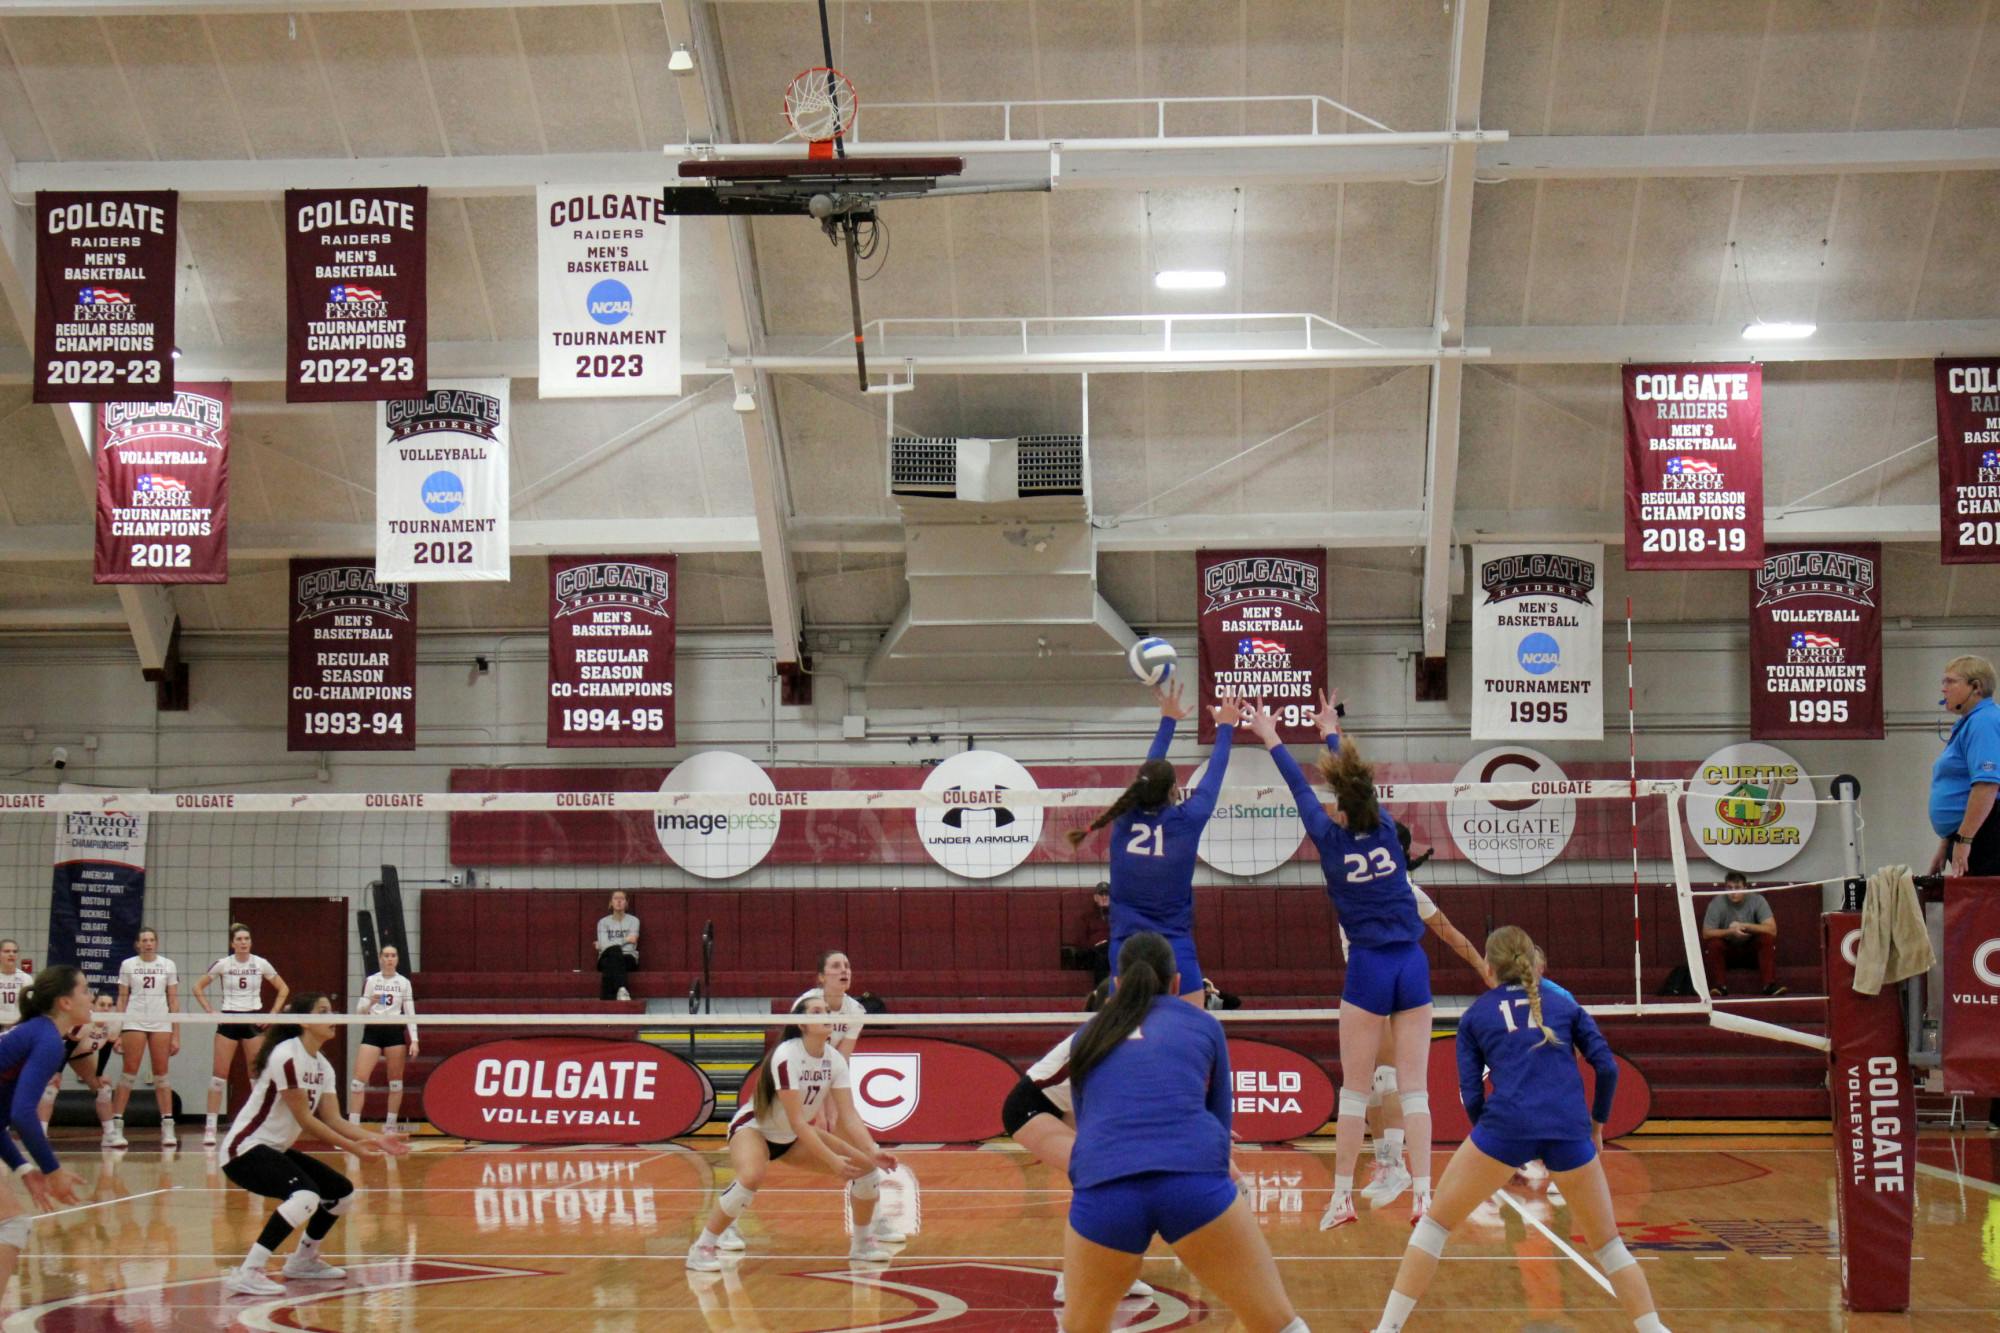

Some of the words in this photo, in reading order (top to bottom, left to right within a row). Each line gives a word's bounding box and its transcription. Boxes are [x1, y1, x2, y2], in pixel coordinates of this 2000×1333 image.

[48, 200, 165, 235] COLGATE
[298, 198, 414, 233] COLGATE
[550, 194, 667, 227] COLGATE
[71, 236, 142, 247] RAIDERS
[321, 233, 392, 246] RAIDERS
[573, 229, 644, 240] RAIDERS
[84, 252, 127, 266] MEN'S
[335, 250, 377, 264] MEN'S
[587, 246, 628, 259] MEN'S
[315, 264, 397, 279] BASKETBALL
[567, 259, 649, 273] BASKETBALL
[64, 266, 146, 281] BASKETBALL
[74, 303, 136, 312] PATRIOT
[325, 301, 388, 311] PATRIOT
[590, 302, 631, 315] NCAA
[74, 312, 136, 321] LEAGUE
[326, 309, 388, 319] LEAGUE
[56, 323, 107, 337] REGULAR
[109, 323, 154, 336] SEASON
[307, 320, 406, 334] TOURNAMENT
[55, 337, 154, 352] CHAMPIONS
[307, 334, 406, 351] CHAMPIONS
[552, 330, 667, 346] TOURNAMENT
[47, 360, 161, 384] 2022-23
[300, 357, 414, 383] 2022-23
[576, 354, 643, 378] 2023
[1635, 373, 1748, 401] COLGATE
[108, 394, 221, 426] COLGATE
[387, 390, 499, 424] COLGATE
[1657, 402, 1728, 419] RAIDERS
[124, 423, 203, 437] RAIDERS
[404, 421, 482, 434] RAIDERS
[1671, 424, 1714, 437] MEN'S
[1650, 438, 1737, 450] BASKETBALL
[119, 451, 207, 465] VOLLEYBALL
[400, 448, 487, 461] VOLLEYBALL
[1663, 473, 1725, 483] PATRIOT
[1662, 481, 1724, 490] LEAGUE
[1957, 486, 2000, 499] TOUR
[132, 489, 192, 500] PATRIOT
[425, 491, 464, 504] NCAA
[1641, 492, 1696, 505] REGULAR
[1699, 491, 1745, 504] SEASON
[132, 497, 191, 507] LEAGUE
[112, 508, 211, 522] TOURNAMENT
[1641, 506, 1746, 521] CHAMPIONS
[112, 521, 211, 537] CHAMPIONS
[389, 519, 496, 534] TOURNAMENT
[1643, 528, 1746, 552] 2018-19
[131, 544, 191, 568] 2012
[413, 541, 473, 564] 2012
[1483, 555, 1594, 587] COLGATE
[1762, 553, 1873, 585] COLGATE
[559, 564, 666, 597] COLGATE
[1207, 559, 1317, 594] COLGATE
[1224, 589, 1302, 602] RAIDERS
[1500, 584, 1577, 598] RAIDERS
[1777, 583, 1856, 596] RAIDERS
[316, 598, 391, 610] RAIDERS
[575, 594, 651, 607] RAIDERS
[1519, 602, 1558, 613] MEN'S
[592, 611, 631, 623] MEN'S
[1242, 607, 1282, 619] MEN'S
[1772, 610, 1860, 623] VOLLEYBALL
[334, 615, 373, 626] MEN'S
[1222, 619, 1303, 632] BASKETBALL
[1498, 615, 1579, 627] BASKETBALL
[314, 628, 393, 640] BASKETBALL
[572, 624, 652, 637] BASKETBALL
[575, 649, 648, 663] REGULAR
[1234, 653, 1291, 662] PATRIOT
[1522, 653, 1560, 665] NCAA
[1787, 648, 1846, 656] PATRIOT
[1787, 655, 1845, 663] LEAGUE
[317, 652, 390, 667] REGULAR
[1234, 660, 1291, 669] LEAGUE
[322, 668, 384, 683] SEASON
[580, 666, 644, 680] SEASON
[1214, 670, 1312, 683] TOURNAMENT
[1766, 665, 1866, 678] TOURNAMENT
[551, 682, 673, 697] CO-CHAMPIONS
[1215, 684, 1312, 698] CHAMPIONS
[1485, 680, 1591, 693] TOURNAMENT
[1767, 678, 1866, 693] CHAMPIONS
[293, 686, 412, 700] CO-CHAMPIONS
[1510, 702, 1568, 723] 1995
[1789, 700, 1849, 723] 1995
[305, 712, 403, 735] 1993-94
[563, 708, 664, 731] 1994-95
[1703, 765, 1798, 785] CURTIS
[1532, 781, 1592, 795] COLGATE
[176, 795, 234, 808] COLGATE
[366, 794, 424, 807] COLGATE
[556, 793, 615, 806] COLGATE
[749, 792, 808, 806] COLGATE
[943, 791, 1003, 804] COLGATE
[1211, 803, 1300, 818] etSmarte
[66, 815, 140, 828] PATRIOT
[1463, 819, 1560, 834] COLGATE
[66, 825, 139, 838] LEAGUE
[1703, 827, 1800, 845] LUMBER
[72, 839, 129, 850] CHAMPIONSHIPS
[929, 835, 971, 845] UNDER
[975, 835, 1029, 844] ARMOUR
[1127, 823, 1164, 857] 21
[1468, 839, 1555, 850] BOOKSTORE
[1344, 847, 1397, 883] 23
[81, 870, 114, 880] AMERICAN
[143, 976, 155, 988] 21
[239, 977, 247, 988] 6
[3, 991, 16, 1004] 10
[474, 1059, 658, 1100] COLGATE
[859, 1067, 905, 1107] C
[803, 1086, 820, 1105] 17
[1232, 1097, 1303, 1113] ENA
[482, 1108, 641, 1125] VOLLEYBALL
[1848, 1065, 1866, 1185] VOLLEYBALL
[1868, 1056, 1904, 1193] COLGATE
